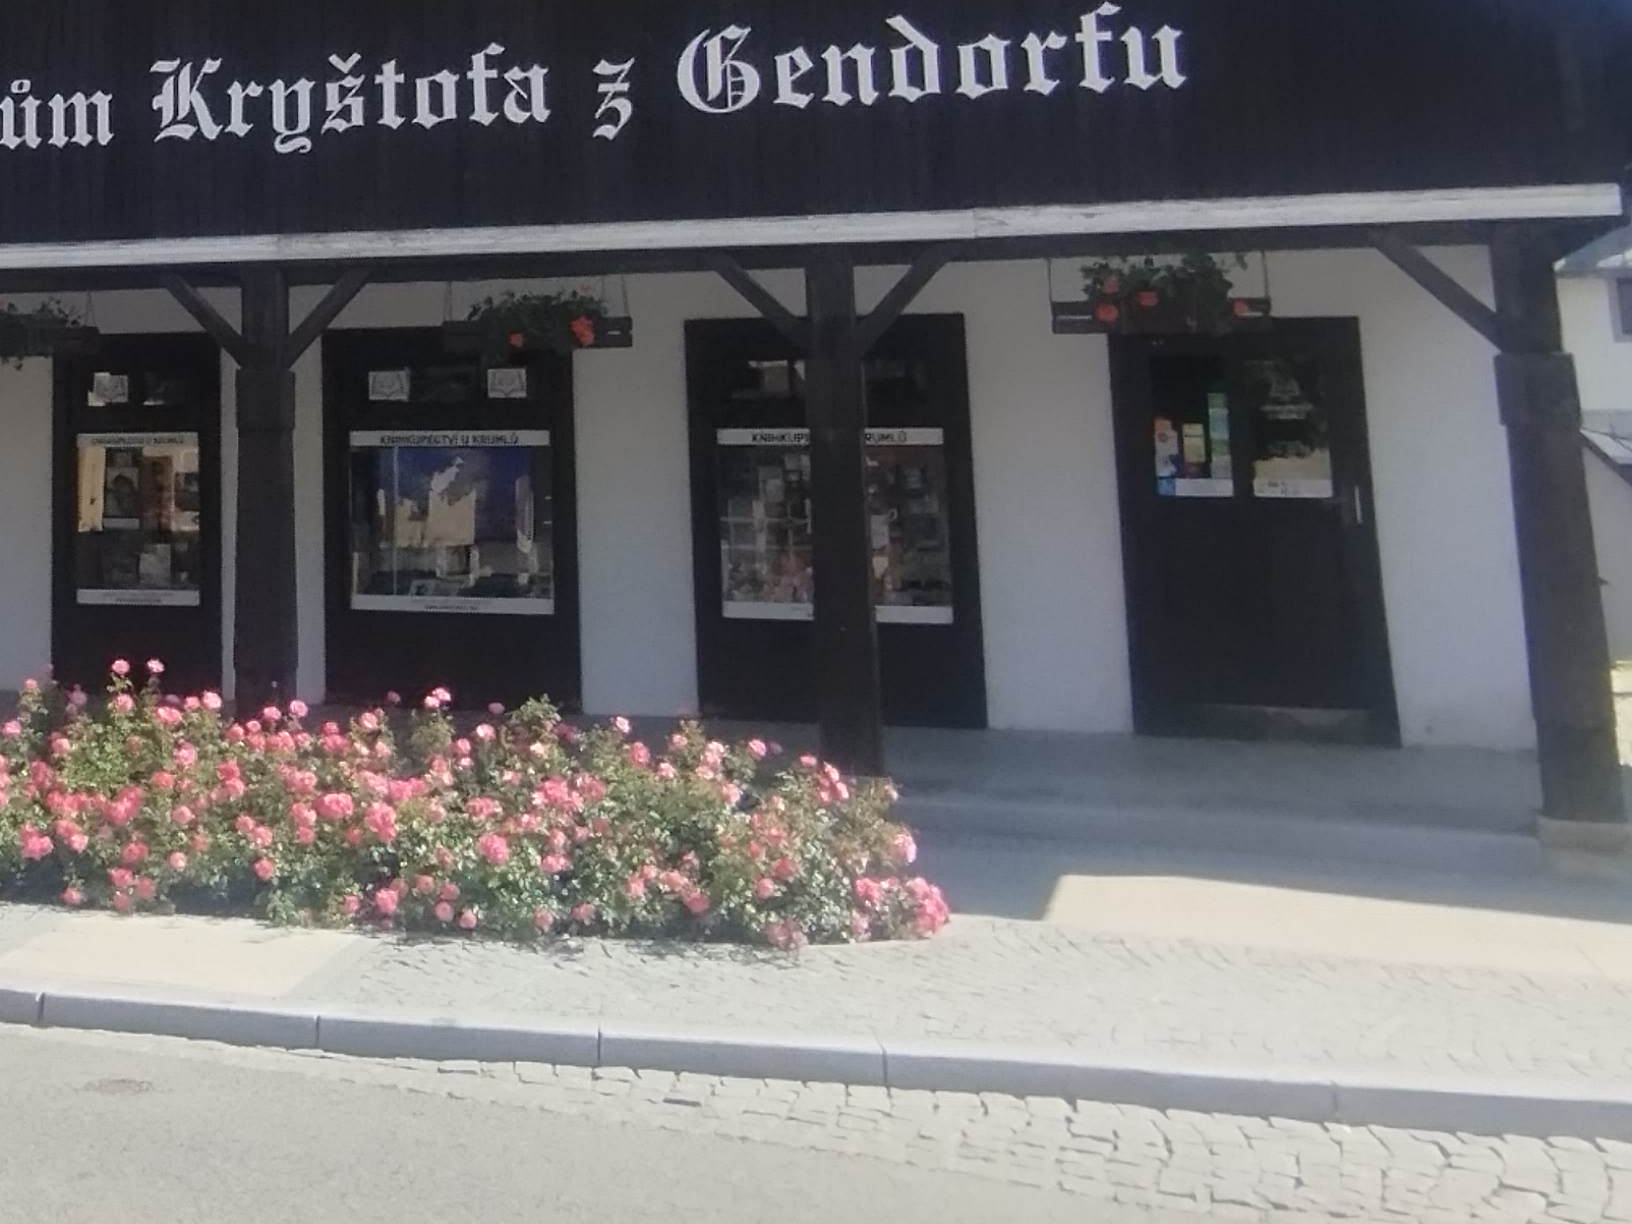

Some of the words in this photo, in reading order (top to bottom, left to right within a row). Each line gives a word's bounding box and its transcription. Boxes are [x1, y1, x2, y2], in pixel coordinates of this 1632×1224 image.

[149, 42, 551, 153] Kryštofa
[592, 57, 635, 140] z
[676, 1, 1187, 113] Gendorfu
